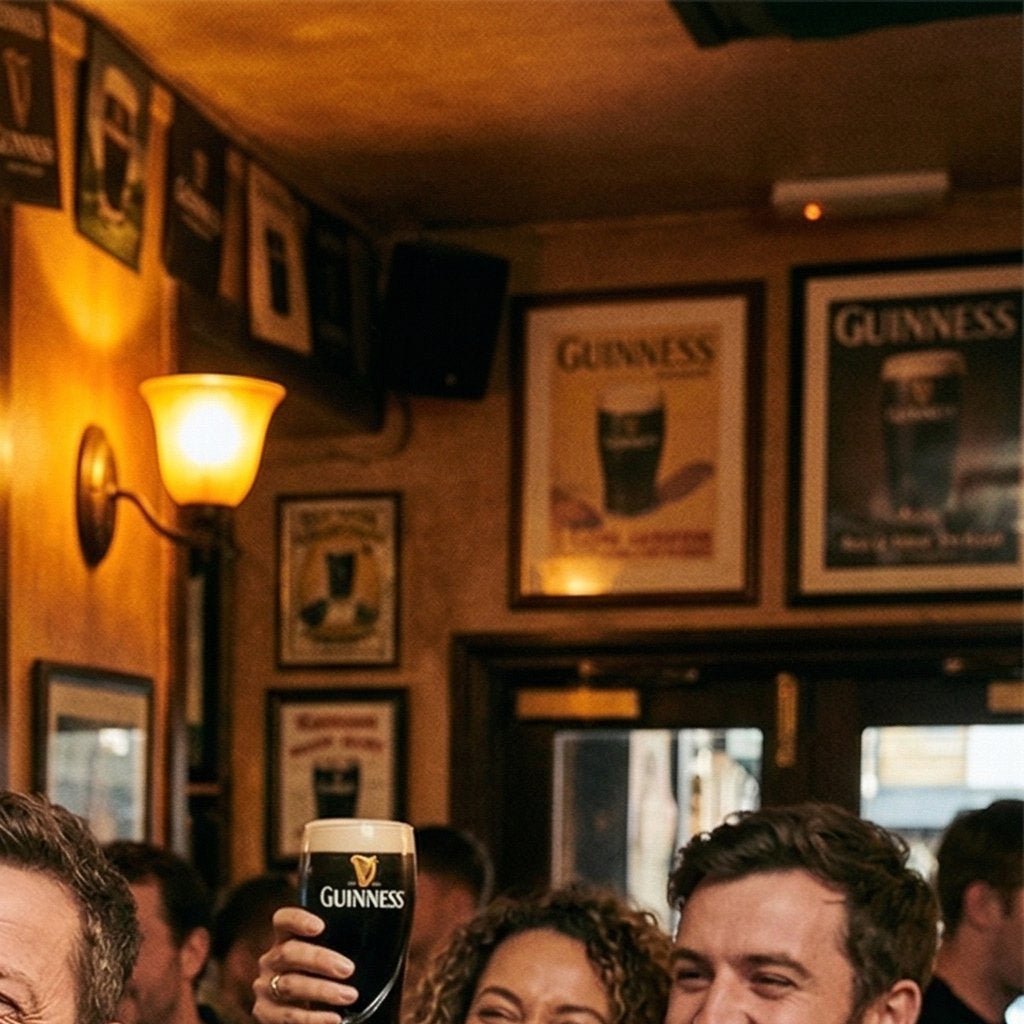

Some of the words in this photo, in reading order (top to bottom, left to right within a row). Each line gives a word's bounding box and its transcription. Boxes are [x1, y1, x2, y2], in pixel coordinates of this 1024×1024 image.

[834, 302, 1018, 347] GUINNESS
[556, 333, 715, 372] GUINNESS
[320, 886, 405, 909] GUINNESS
